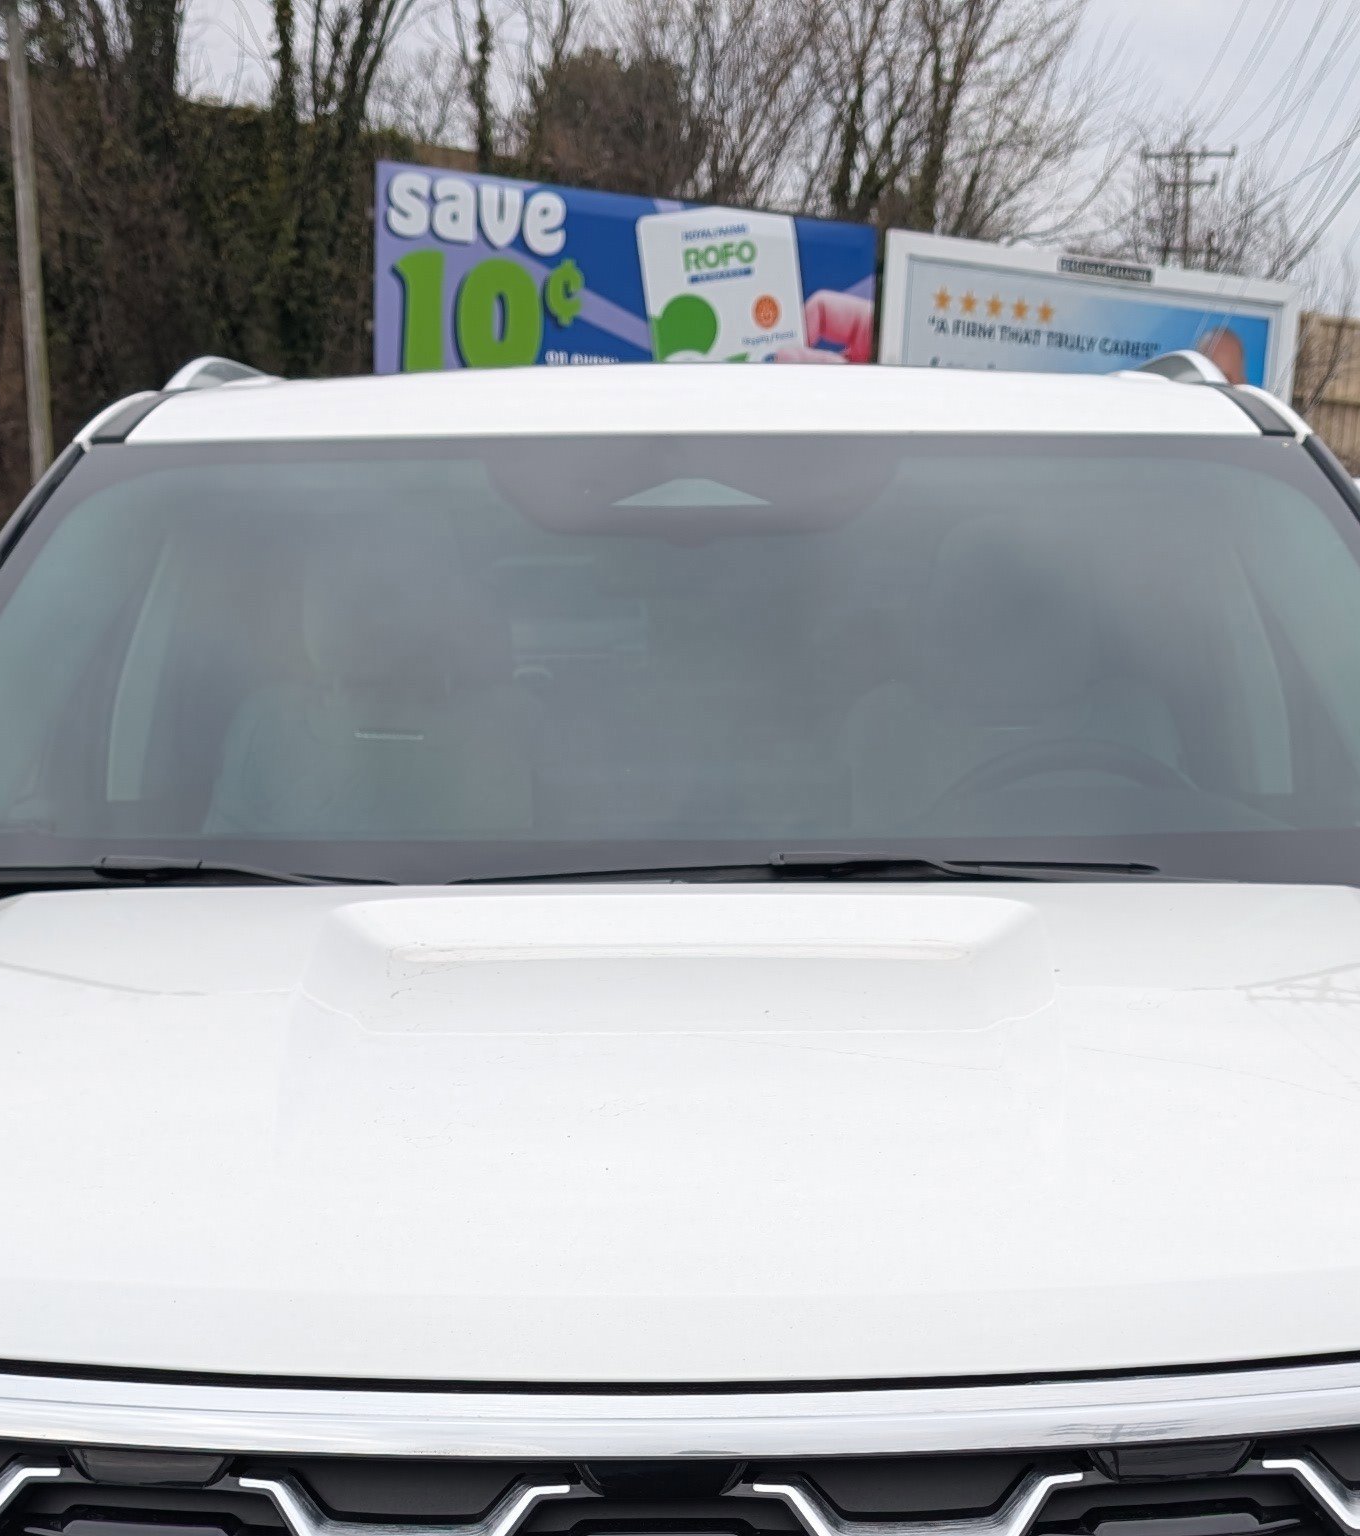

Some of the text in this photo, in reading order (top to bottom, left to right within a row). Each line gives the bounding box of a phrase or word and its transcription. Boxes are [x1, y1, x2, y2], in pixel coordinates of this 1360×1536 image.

[387, 172, 568, 258] save
[683, 240, 757, 273] ROFO
[999, 325, 1042, 346] THAT
[1045, 331, 1097, 353] TRULY
